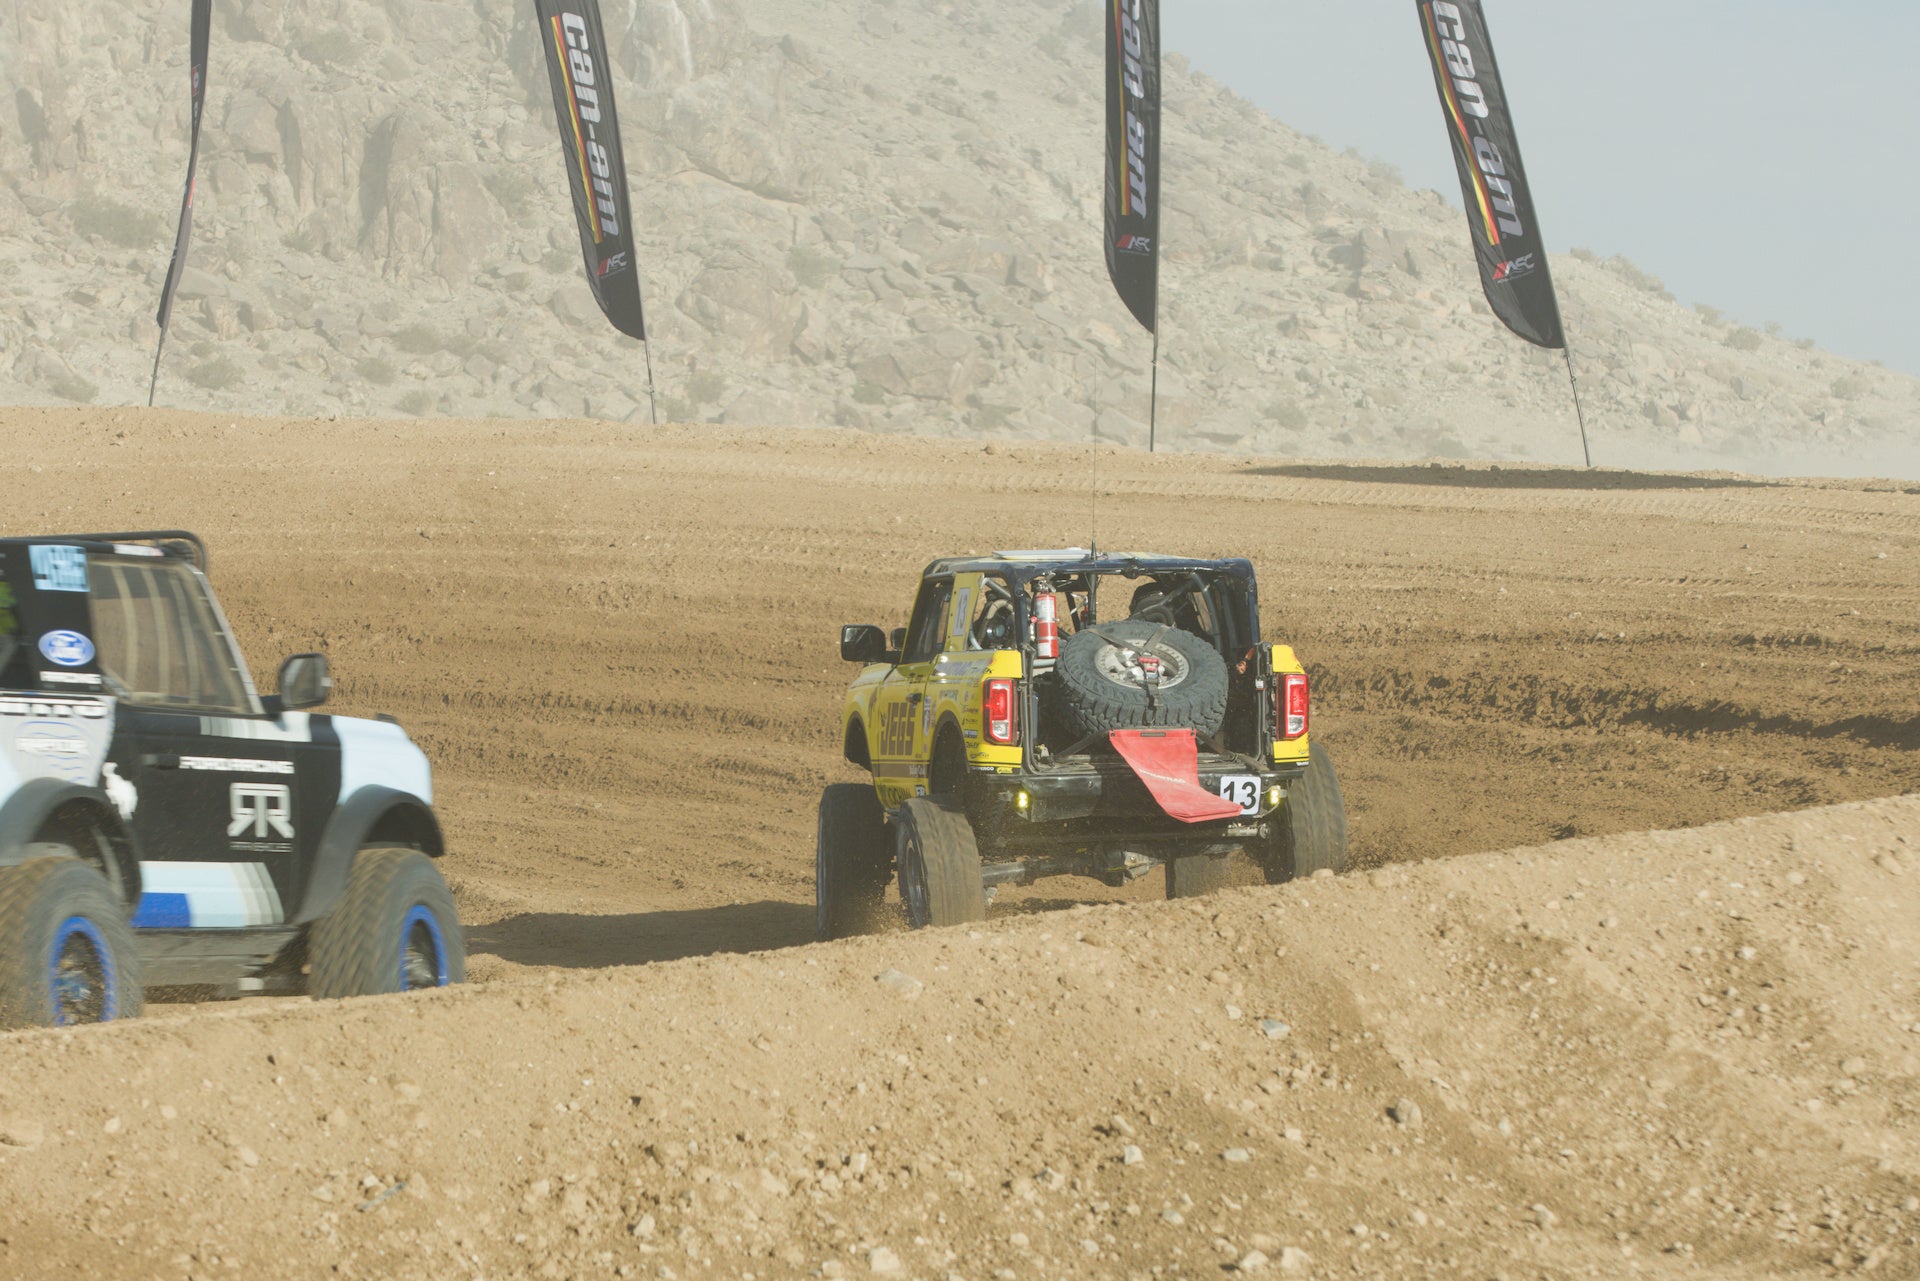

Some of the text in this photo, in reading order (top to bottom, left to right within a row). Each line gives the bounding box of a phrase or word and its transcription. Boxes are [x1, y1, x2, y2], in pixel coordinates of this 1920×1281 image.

[562, 12, 619, 236] can-am
[1432, 0, 1523, 237] can-am
[1223, 781, 1257, 810] 13
